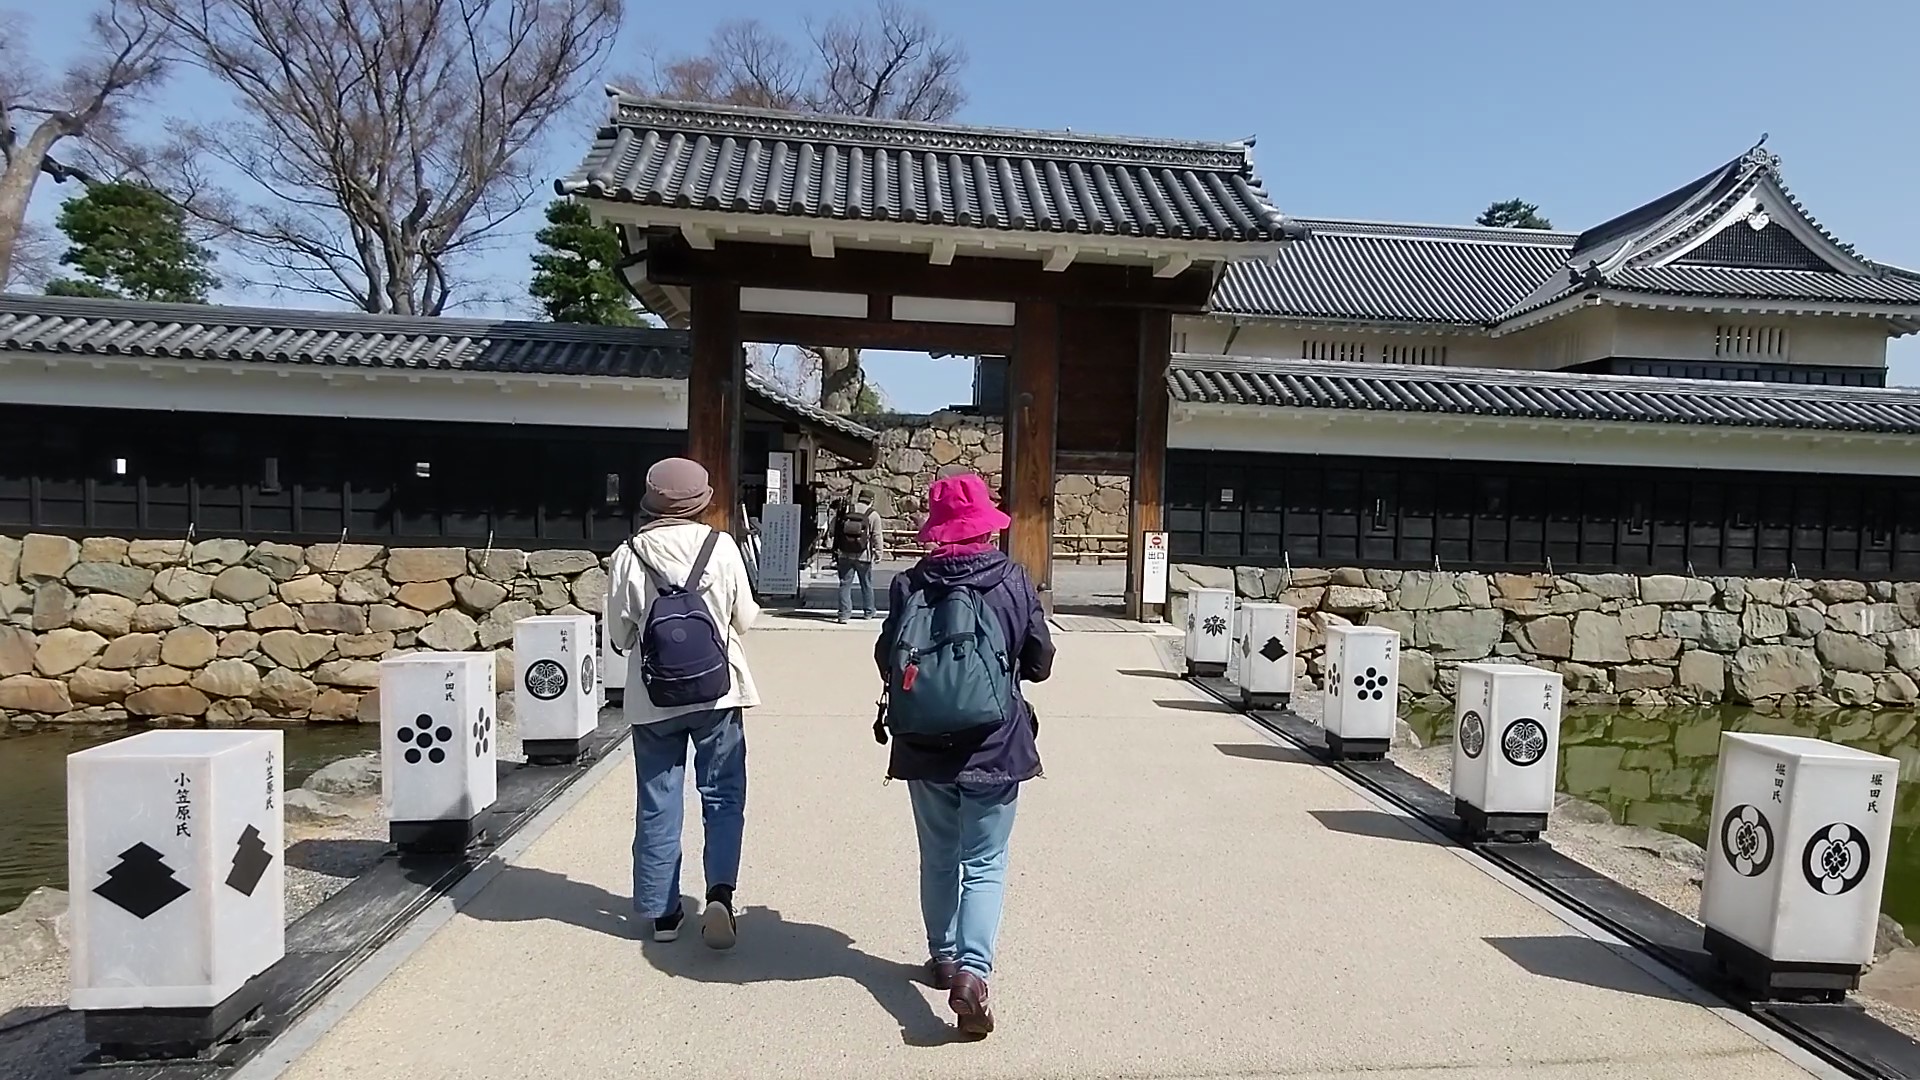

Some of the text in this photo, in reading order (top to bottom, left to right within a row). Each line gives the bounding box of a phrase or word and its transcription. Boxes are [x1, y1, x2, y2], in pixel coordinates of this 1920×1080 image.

[1148, 552, 1165, 560] 出口
[445, 670, 455, 702] 戸田氏
[1543, 683, 1552, 710] 松平氏
[265, 751, 274, 810] 小笠原氏
[1772, 763, 1786, 803] 堀田氏
[1867, 774, 1883, 814] 堀田氏
[174, 772, 192, 837] 小笠原氏
